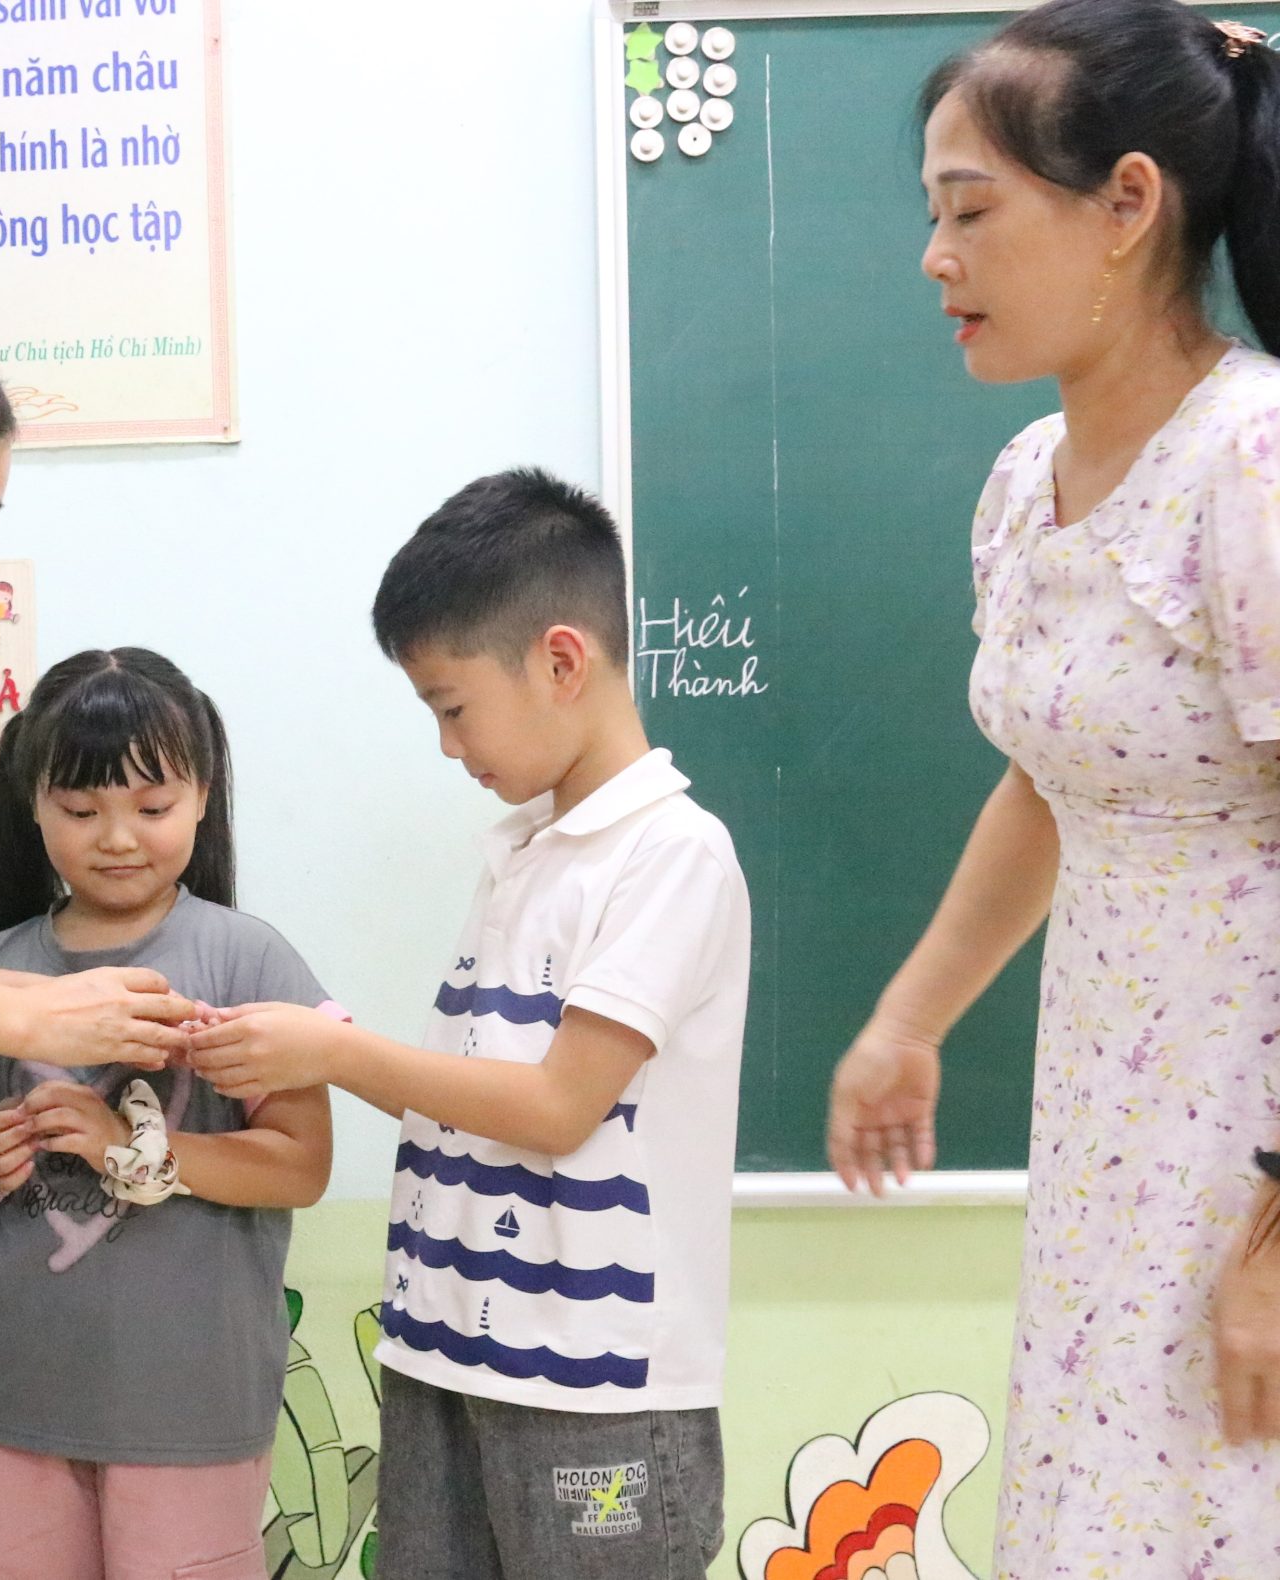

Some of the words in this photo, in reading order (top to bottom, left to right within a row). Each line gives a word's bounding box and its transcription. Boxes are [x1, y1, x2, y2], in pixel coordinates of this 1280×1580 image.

[3, 57, 78, 97] năm
[93, 50, 178, 92] châu
[81, 127, 107, 168] là
[122, 124, 180, 166] nhờ
[62, 203, 119, 254] học
[130, 200, 182, 251] tập
[15, 339, 47, 362] Chủ
[53, 340, 84, 364] tịch
[91, 335, 113, 359] Hồ
[118, 337, 147, 358] Chí
[152, 335, 202, 357] Minh)
[637, 647, 769, 698] Thành
